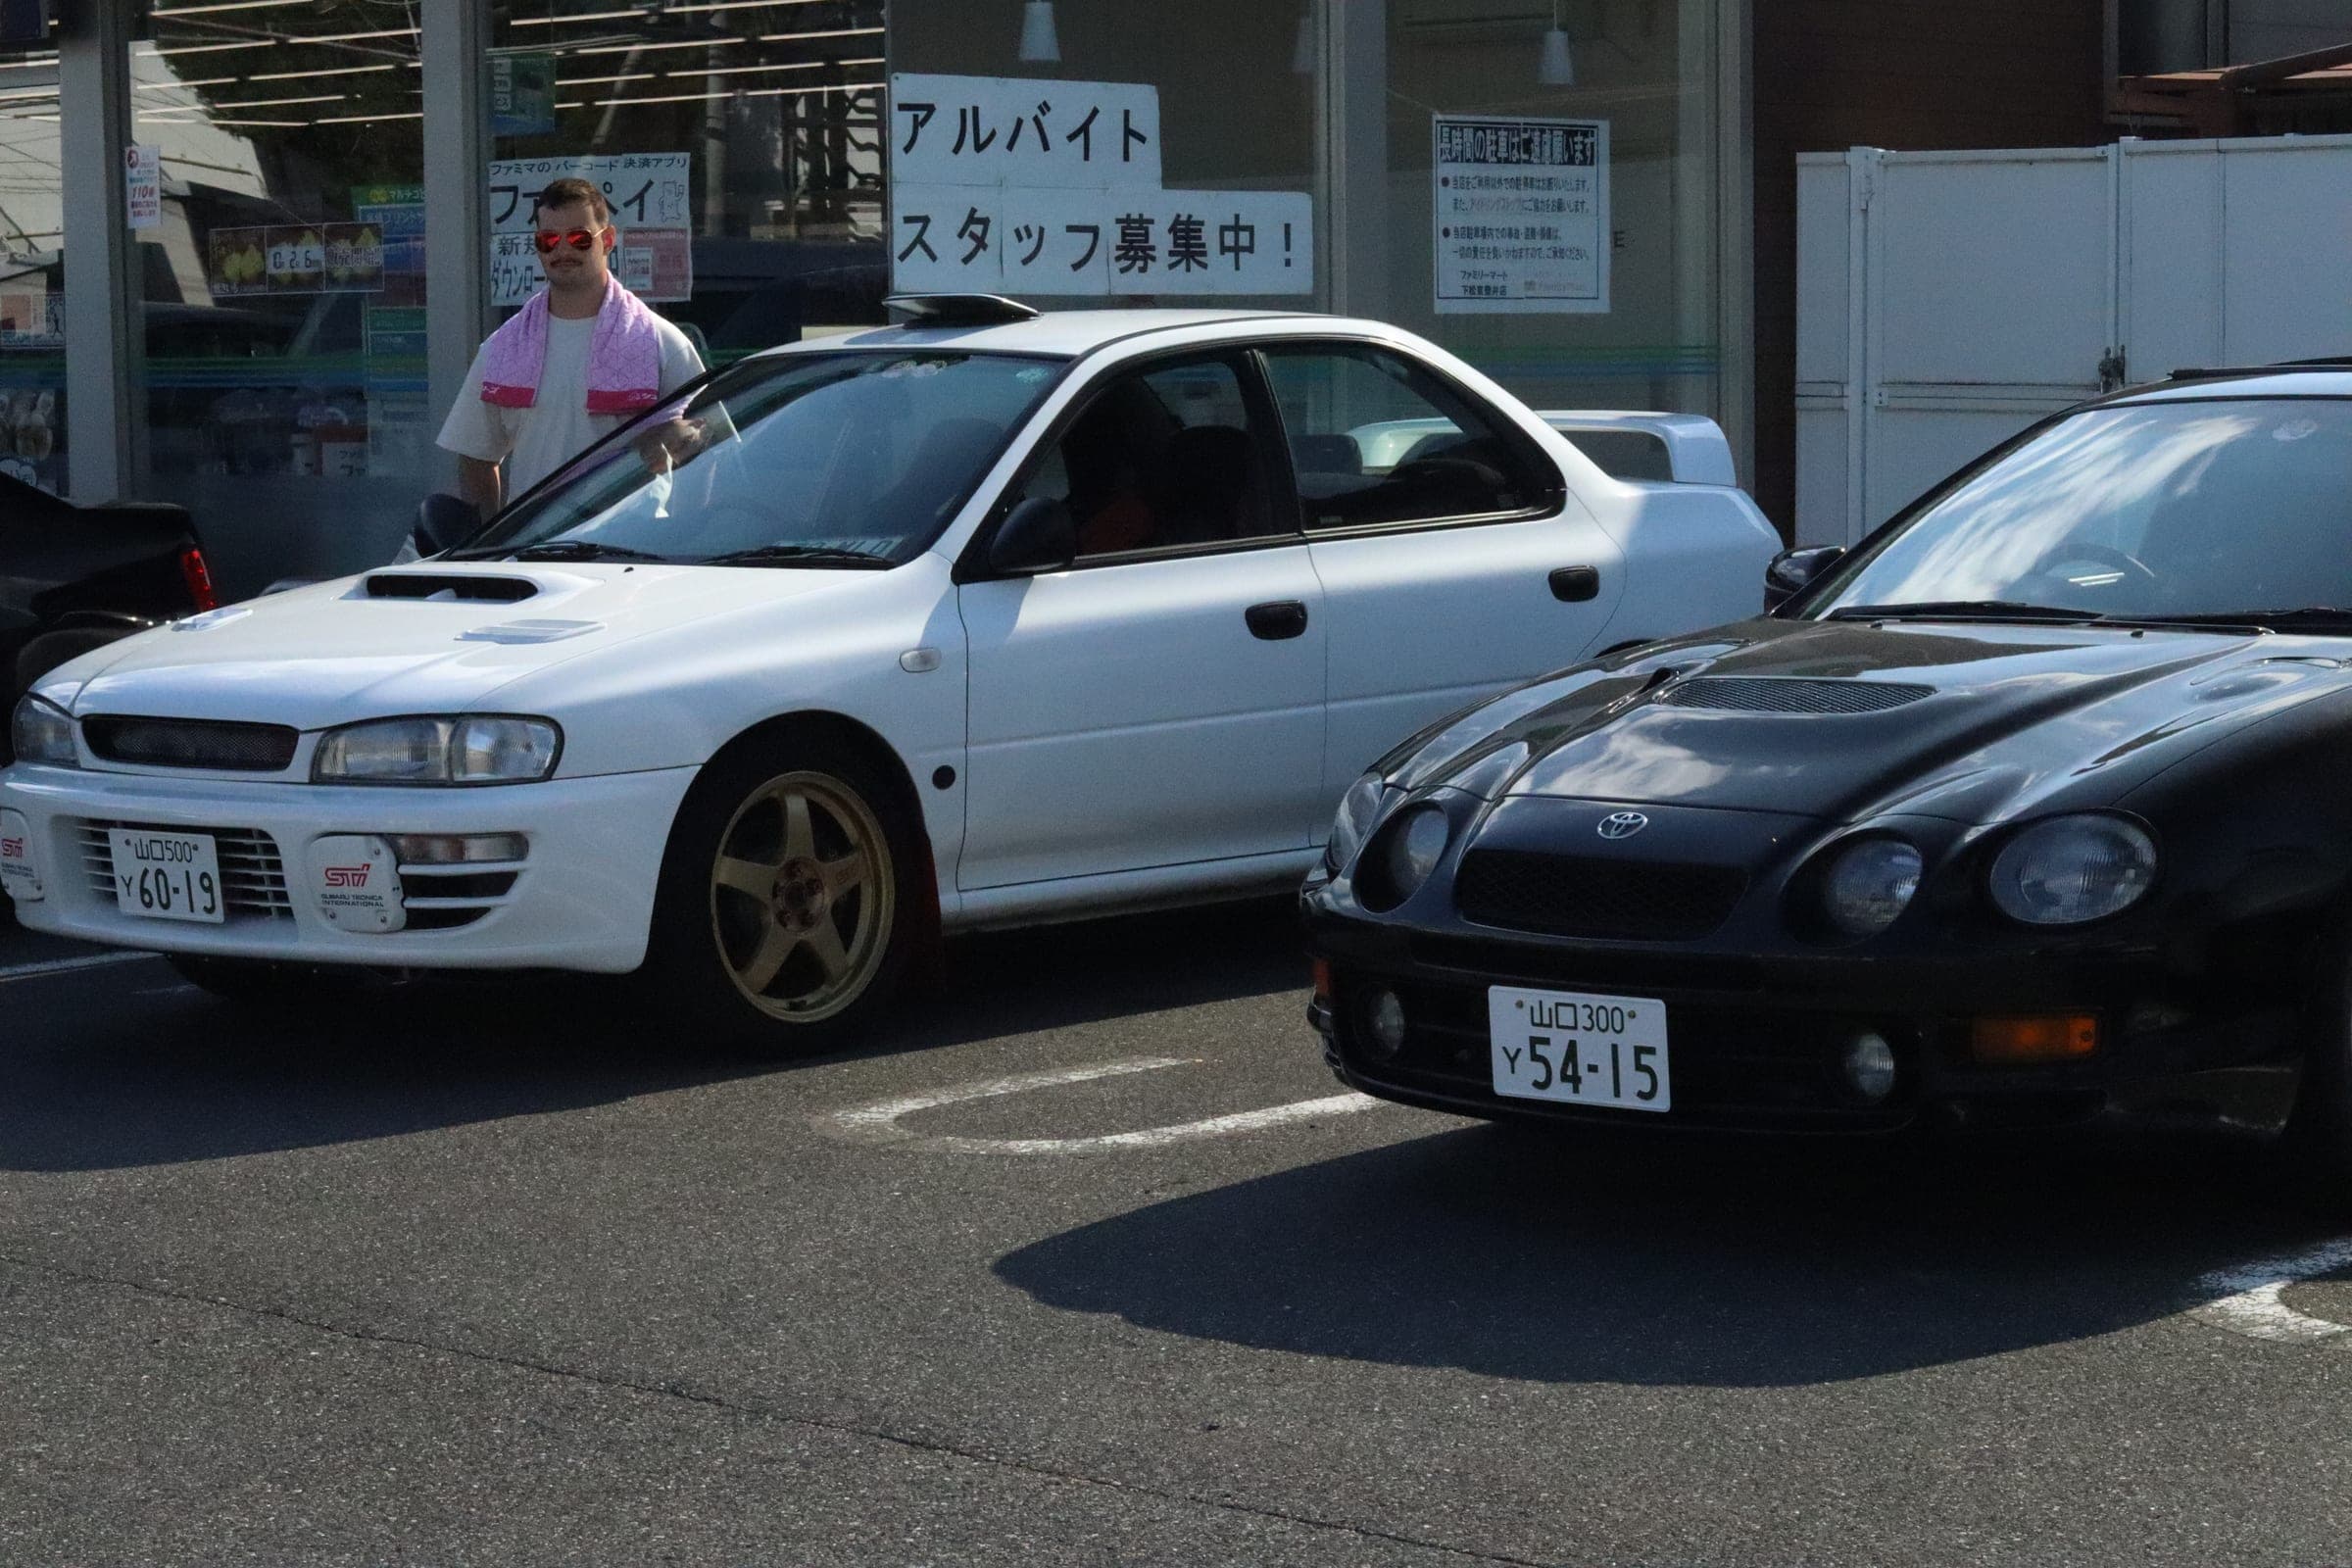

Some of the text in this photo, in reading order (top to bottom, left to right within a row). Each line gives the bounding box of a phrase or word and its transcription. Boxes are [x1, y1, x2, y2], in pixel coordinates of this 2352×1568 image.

[898, 100, 1148, 162] アルバイト
[490, 162, 551, 175] ファミマの
[623, 157, 687, 170] 決済アプリ
[139, 866, 216, 915] 60-19
[1501, 1035, 1659, 1102] Y 54-15
